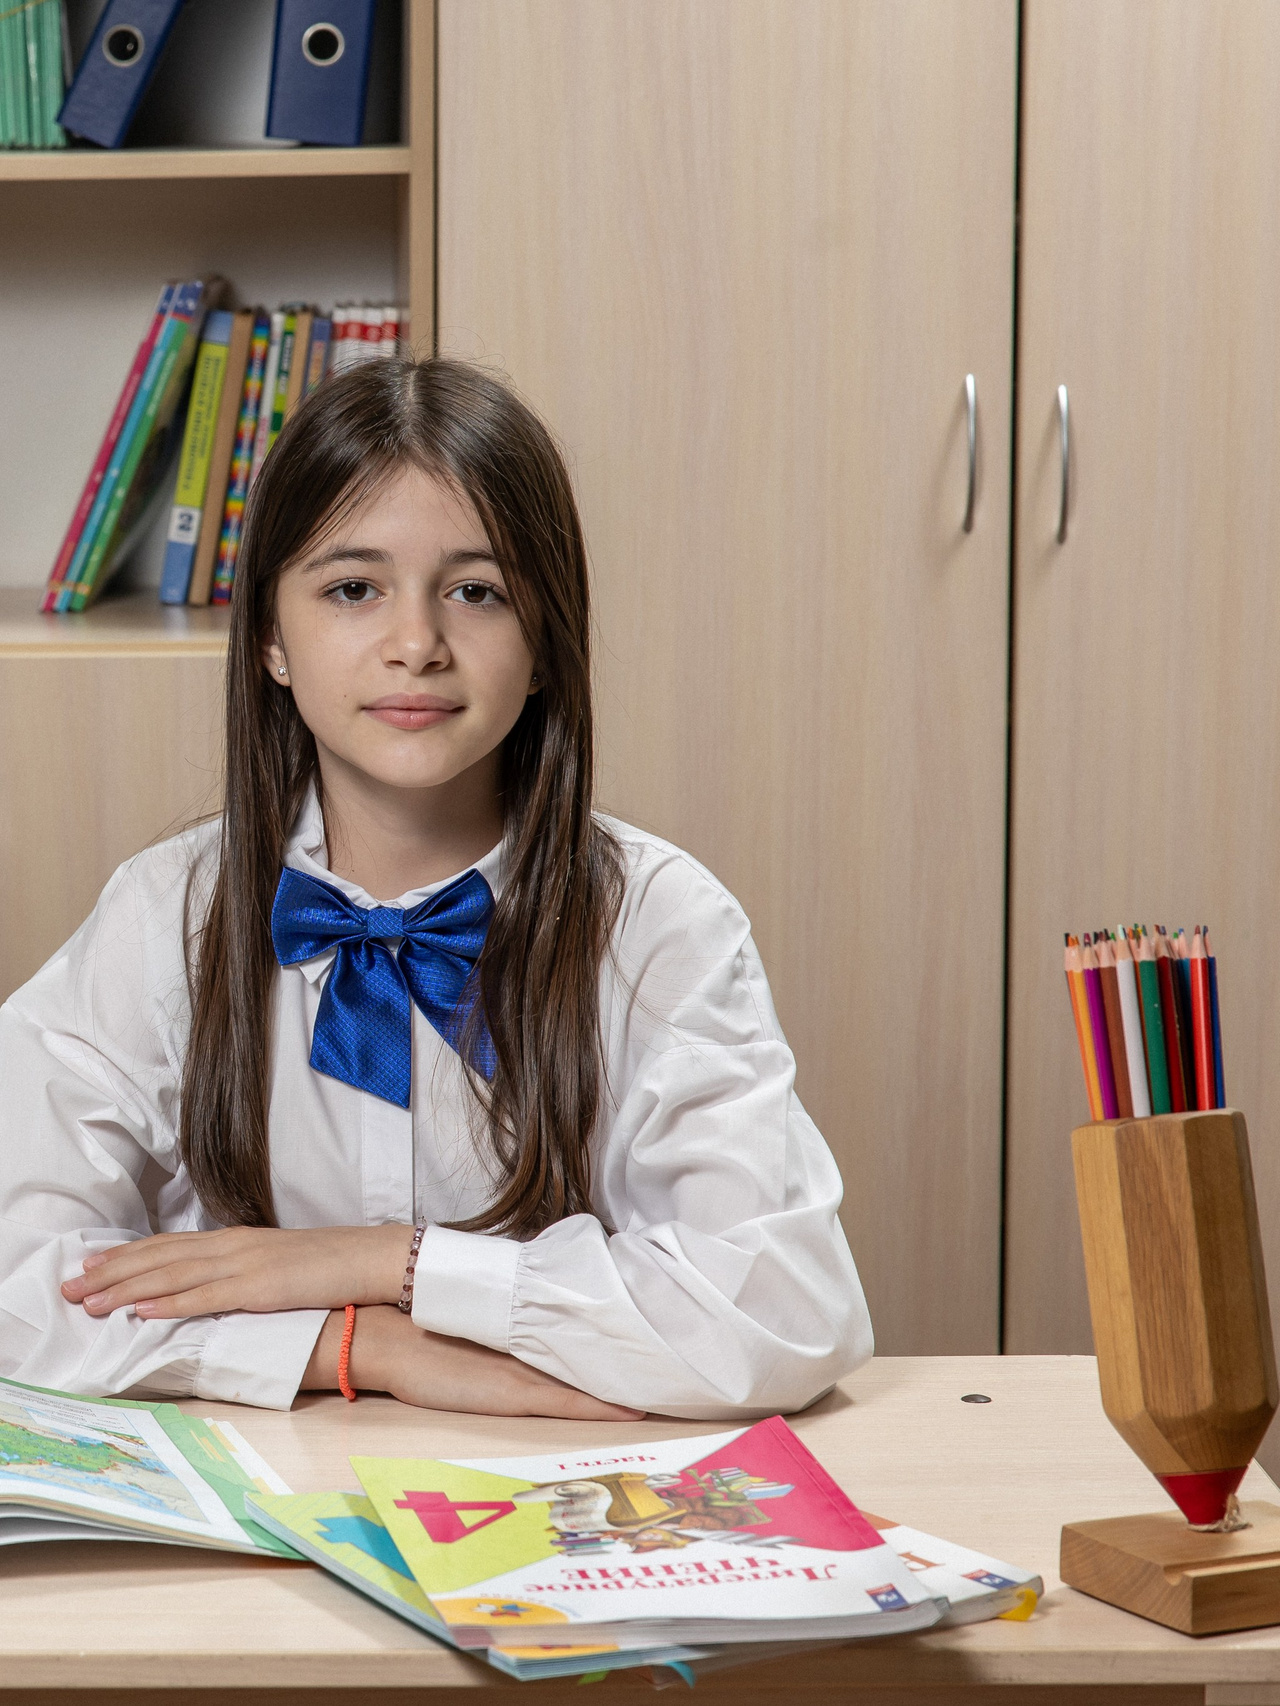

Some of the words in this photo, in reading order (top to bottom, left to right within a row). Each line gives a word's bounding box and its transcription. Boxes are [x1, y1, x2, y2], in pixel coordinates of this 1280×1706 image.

[557, 1462, 567, 1470] 1
[573, 1454, 657, 1470] Часть
[393, 1489, 517, 1543] 4
[522, 1564, 838, 1593] Литературное
[559, 1555, 780, 1582] ЧТЕНИЕ
